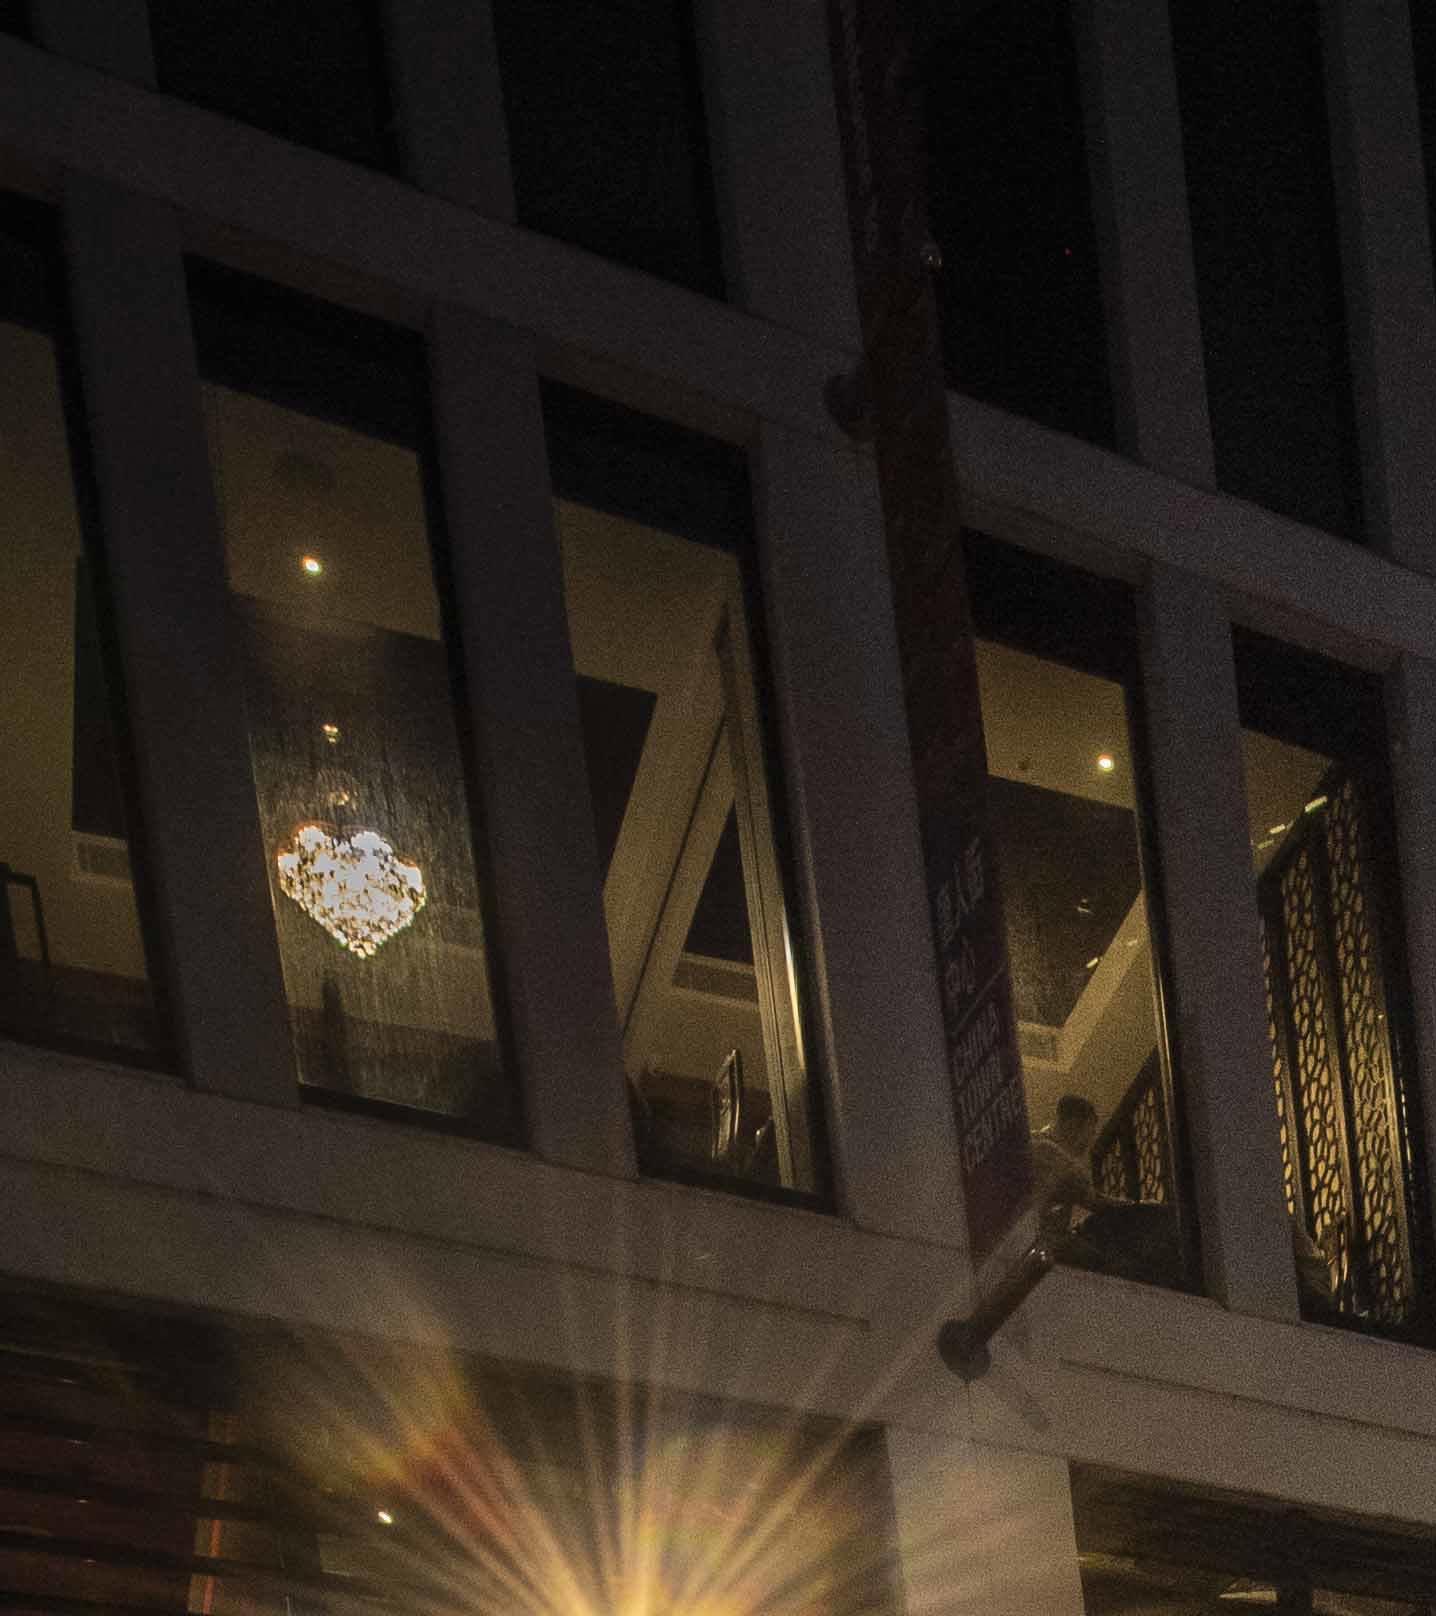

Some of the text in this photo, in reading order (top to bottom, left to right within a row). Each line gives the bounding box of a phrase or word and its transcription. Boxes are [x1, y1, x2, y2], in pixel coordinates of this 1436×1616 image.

[953, 1002, 1001, 1086] CHINA
[957, 1055, 1004, 1129] TOWN
[962, 1085, 1023, 1174] CENTRE
